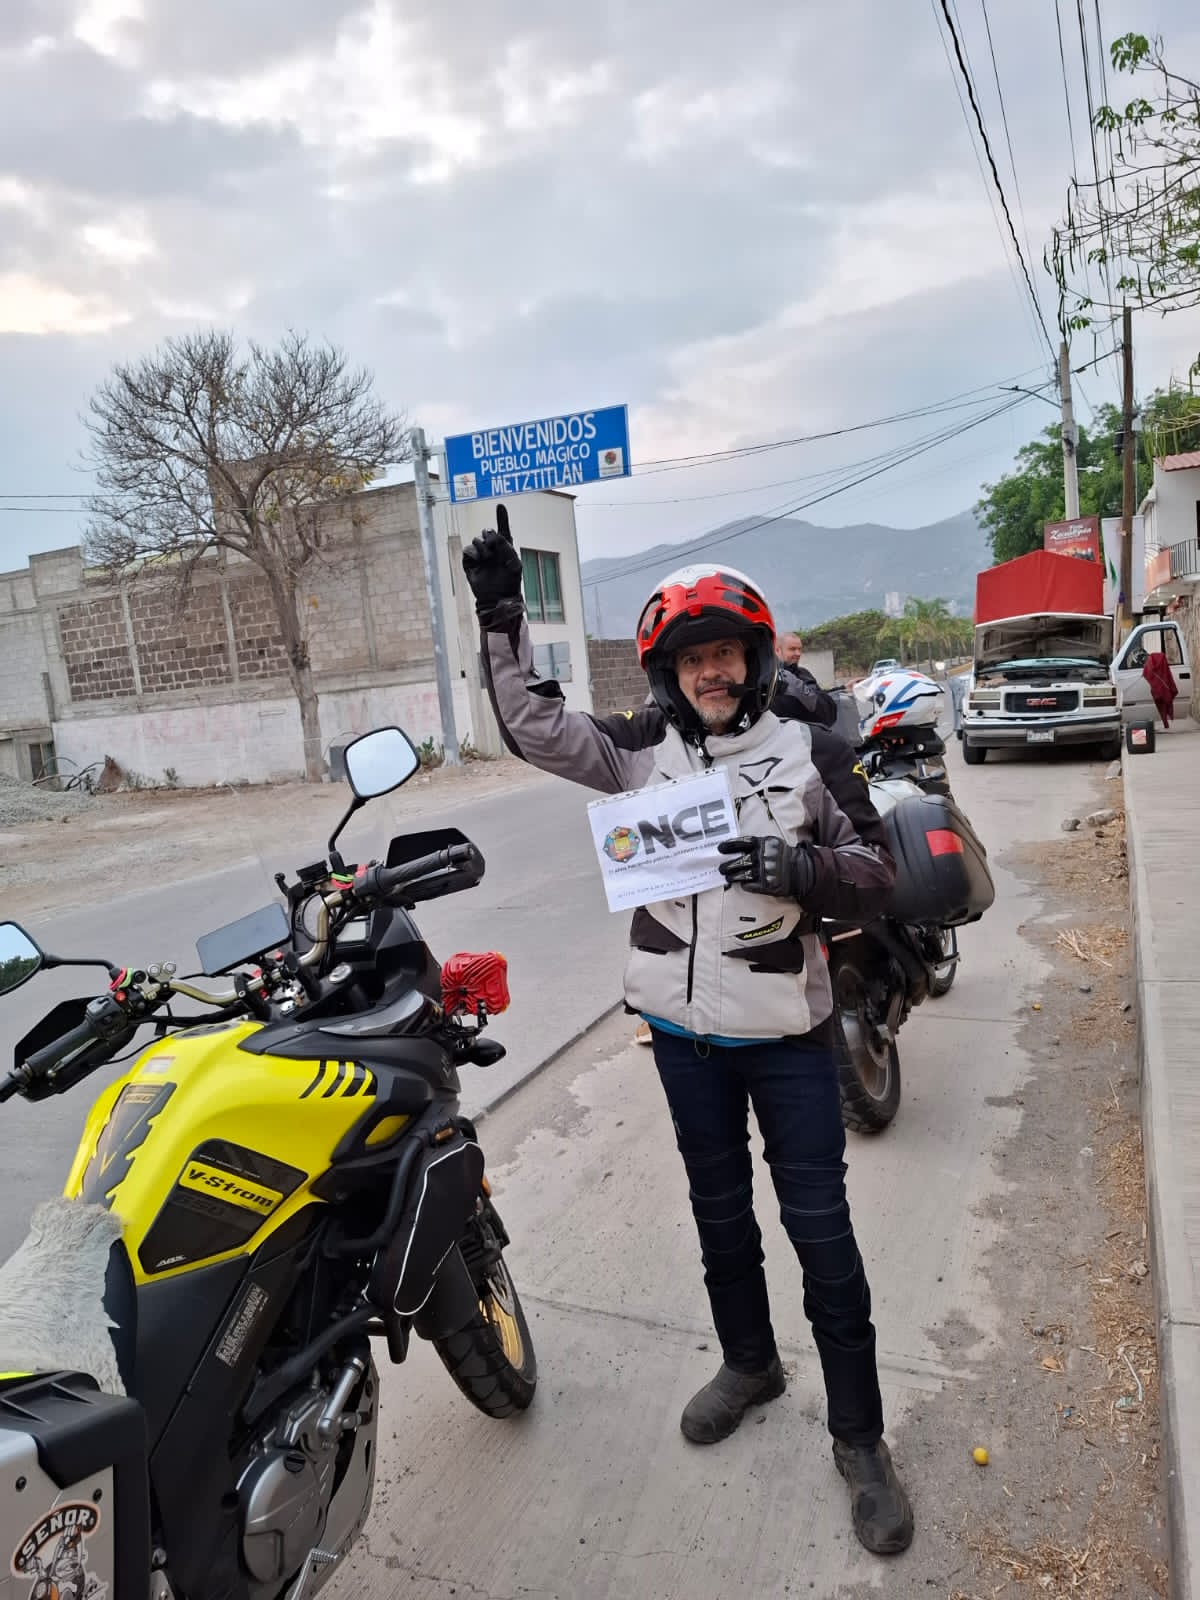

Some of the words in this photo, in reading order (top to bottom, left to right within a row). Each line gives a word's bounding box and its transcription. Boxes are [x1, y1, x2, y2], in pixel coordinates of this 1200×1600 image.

[472, 413, 597, 459] BIENVENIDOS
[481, 453, 530, 476] PUEBLO
[1026, 697, 1056, 705] GMC
[188, 1168, 273, 1207] V-Strom
